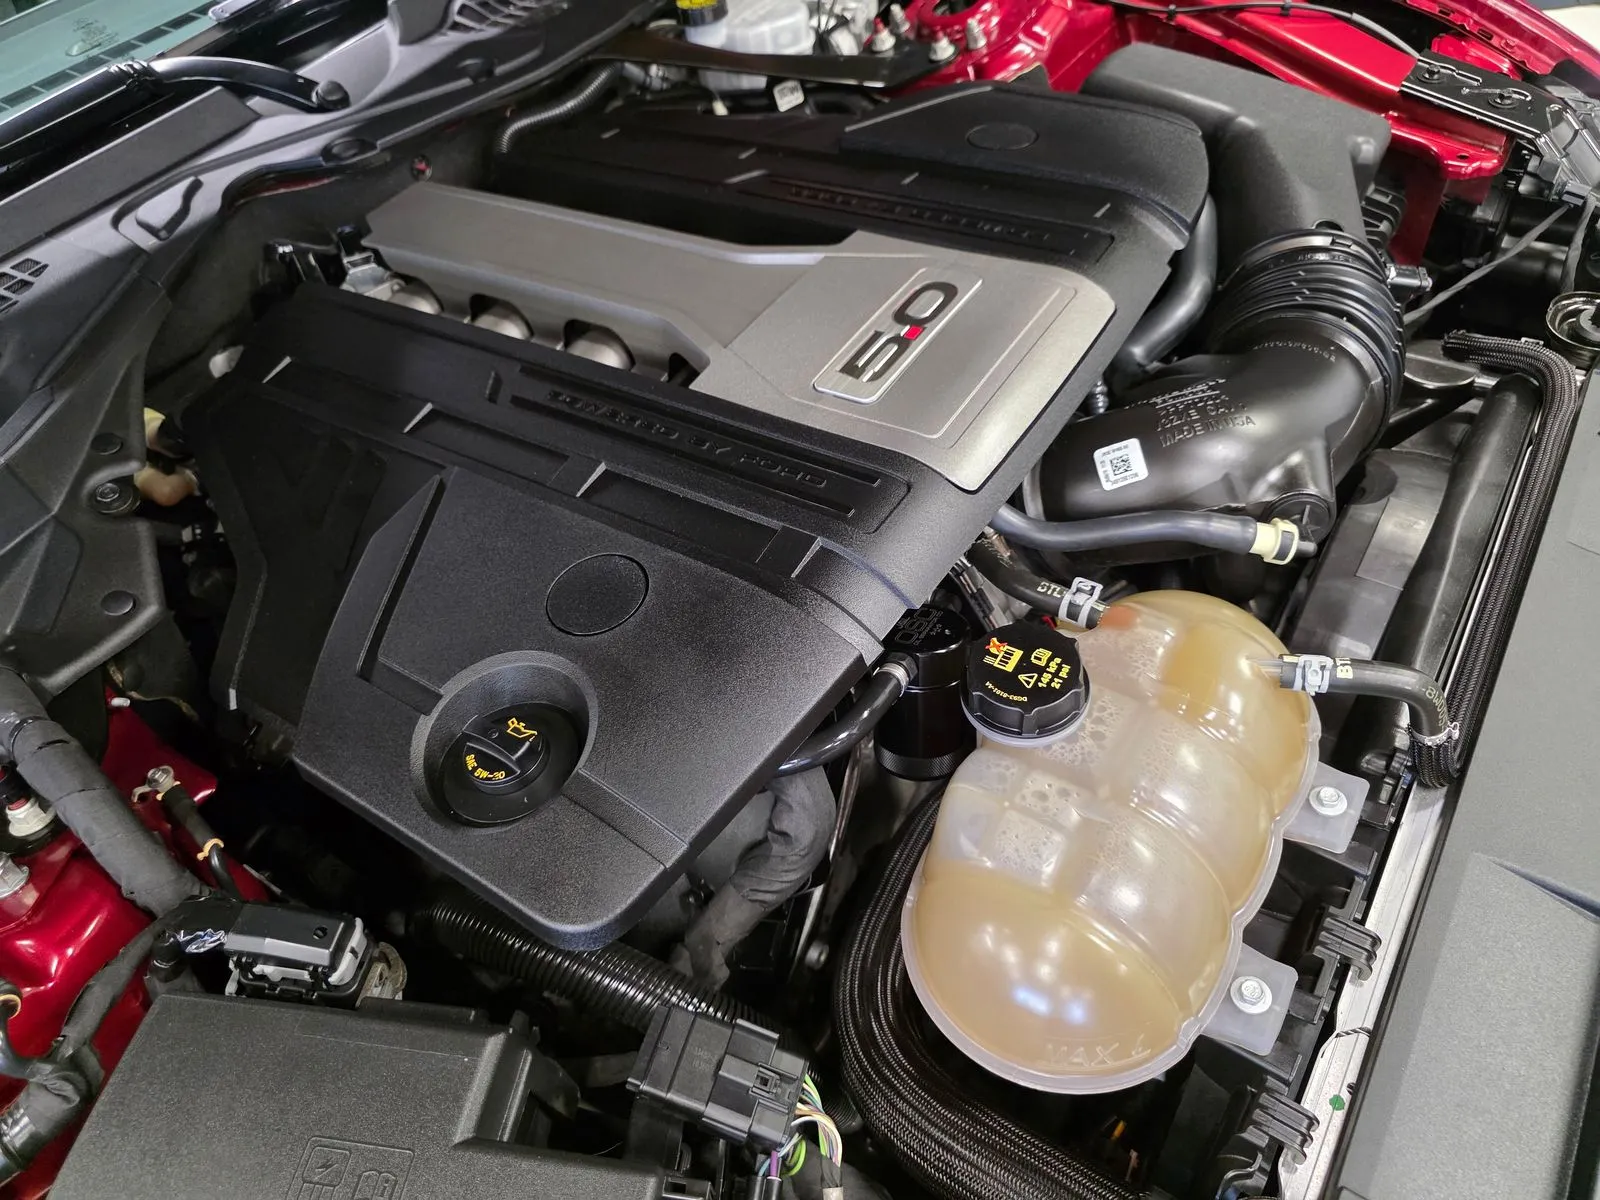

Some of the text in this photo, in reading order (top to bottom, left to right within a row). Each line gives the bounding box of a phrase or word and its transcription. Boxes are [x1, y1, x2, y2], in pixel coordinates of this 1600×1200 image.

[838, 281, 958, 383] 5.0
[1160, 423, 1205, 448] MADE
[739, 452, 827, 489] FORD
[1037, 657, 1062, 688] 145 kPa
[1050, 664, 1071, 690] 21 psi
[465, 753, 478, 771] SAE
